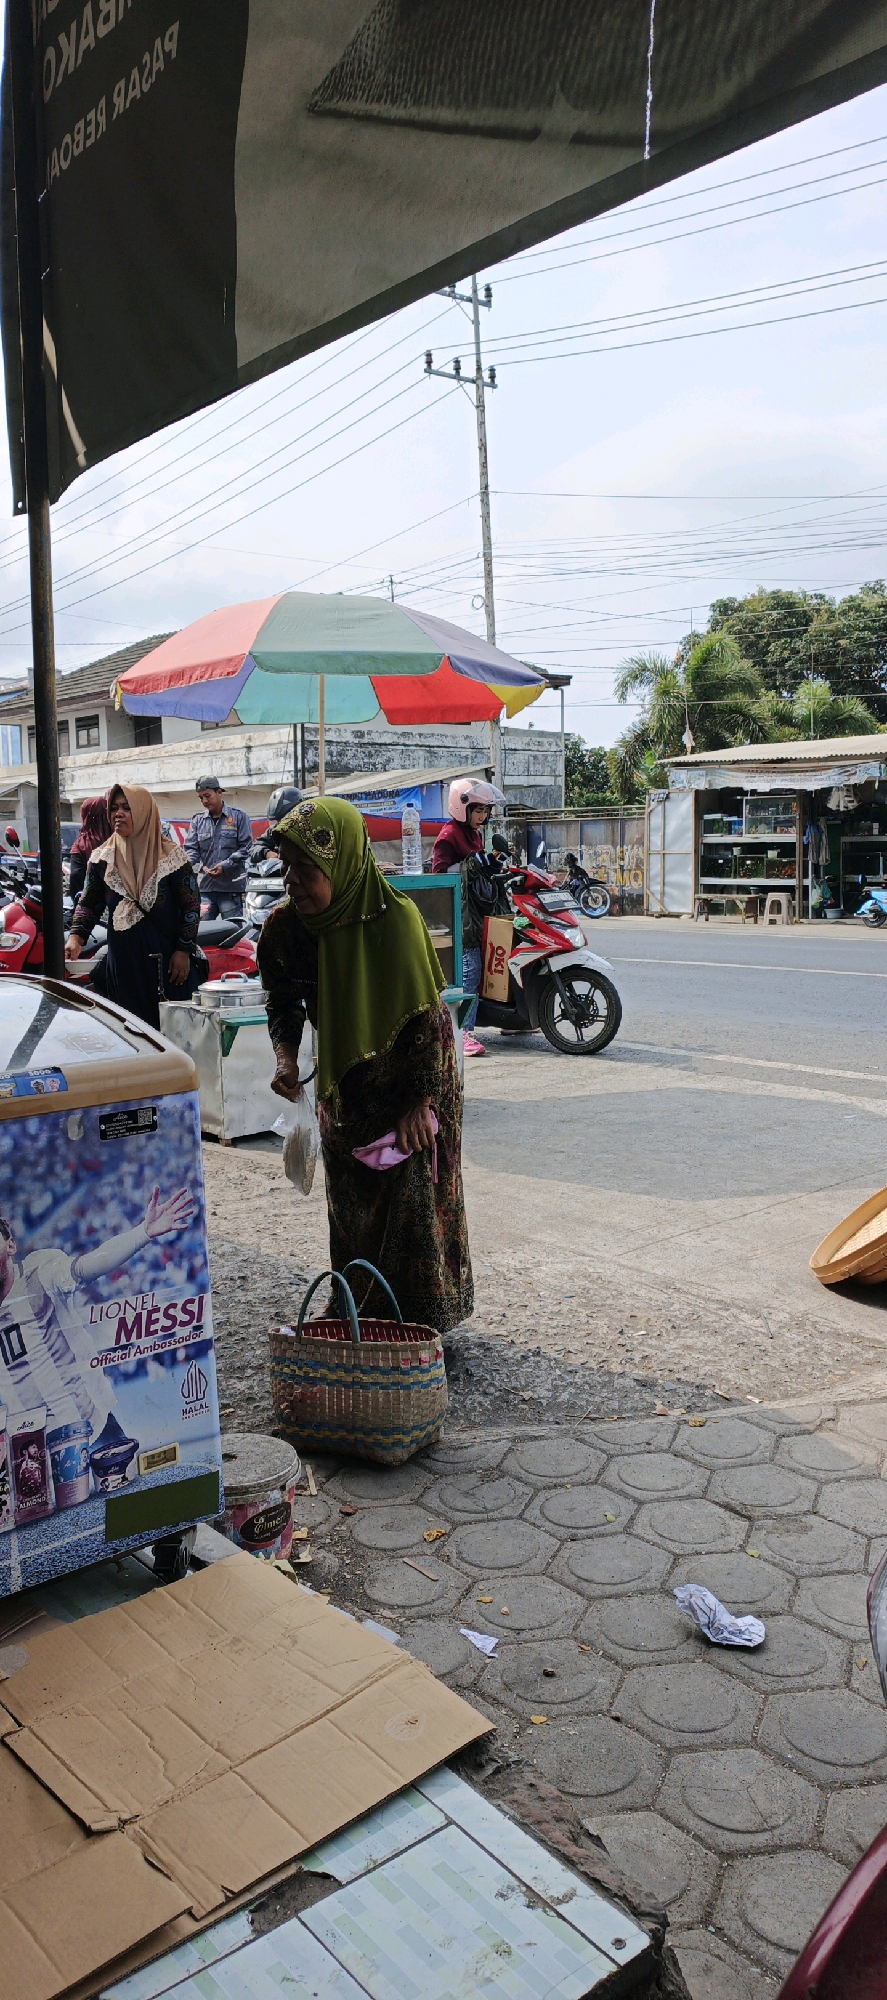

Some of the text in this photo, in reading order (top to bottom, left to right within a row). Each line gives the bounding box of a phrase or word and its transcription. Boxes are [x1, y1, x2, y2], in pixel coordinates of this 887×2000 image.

[494, 945, 507, 976] OKI
[89, 1292, 159, 1325] LIONEL
[114, 1295, 204, 1346] MESSI
[0, 1323, 28, 1366] 10
[90, 1330, 204, 1369] Official Ambassador
[182, 1402, 210, 1416] HALAL
[19, 1496, 46, 1509] ALMOND
